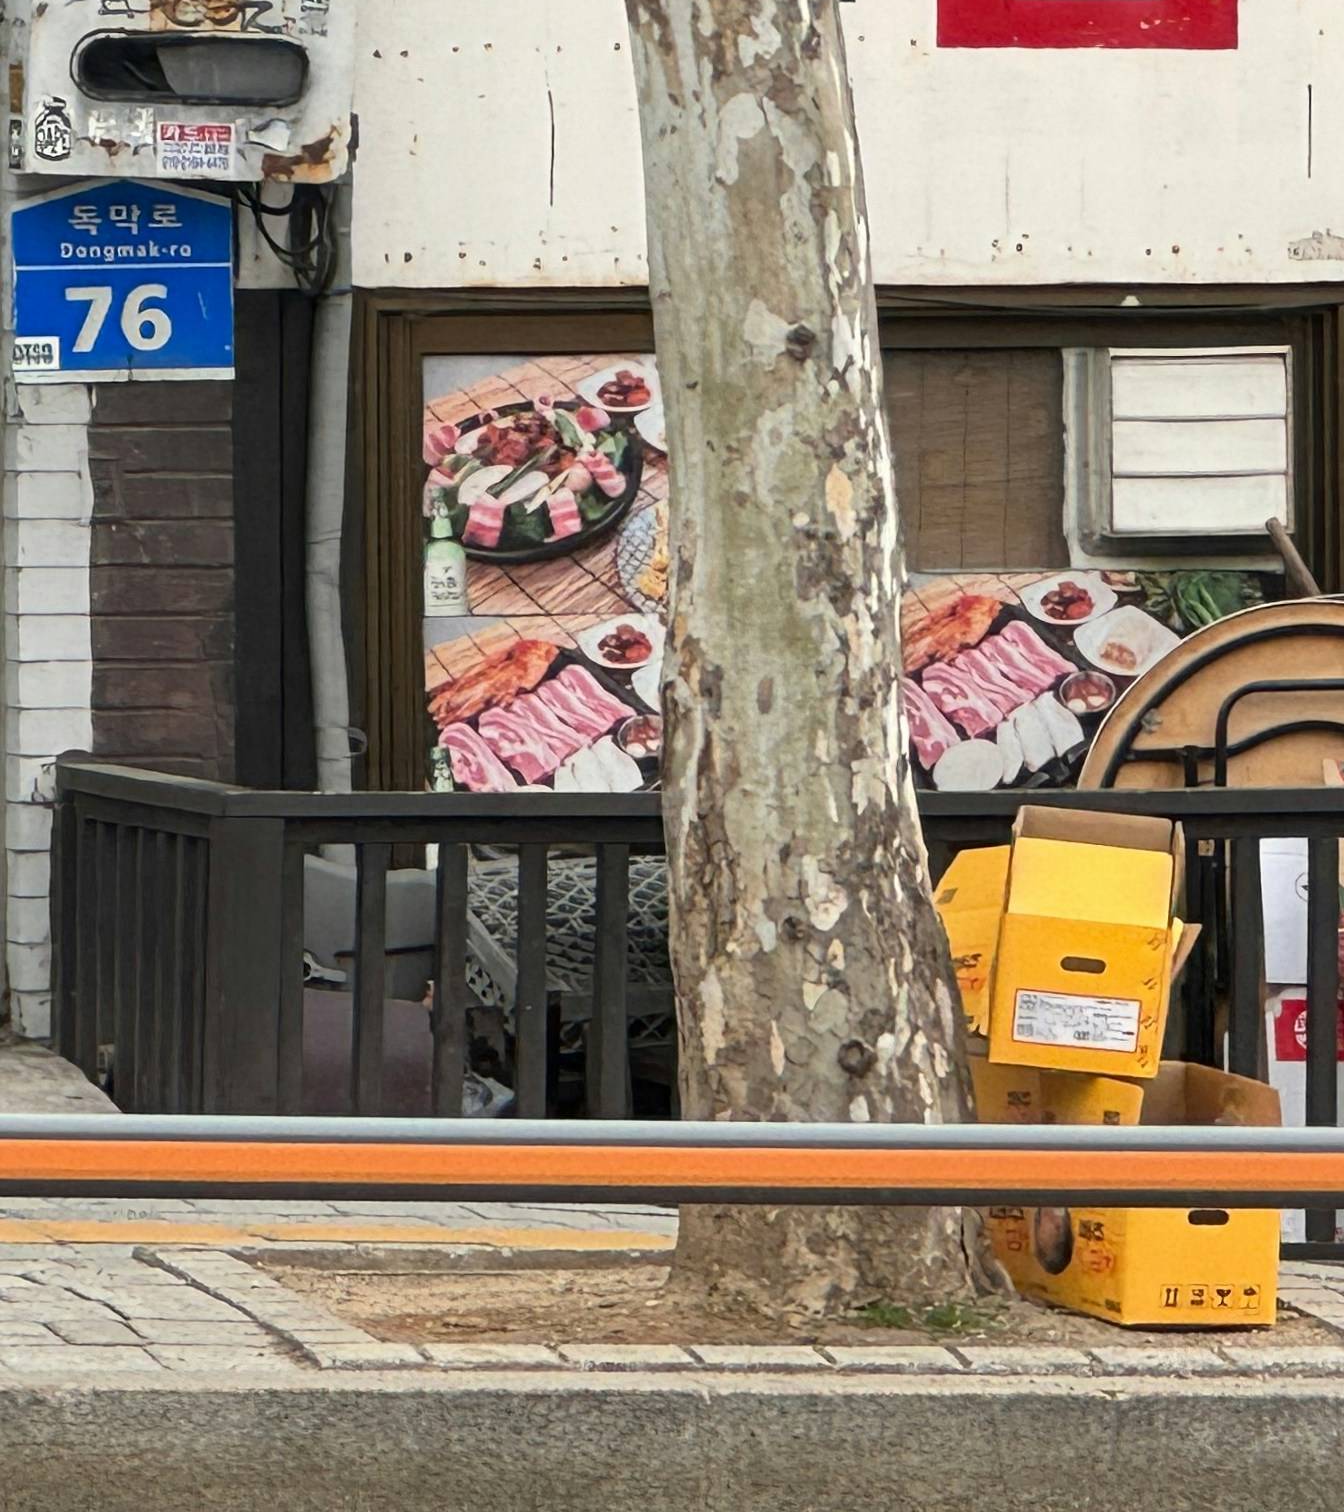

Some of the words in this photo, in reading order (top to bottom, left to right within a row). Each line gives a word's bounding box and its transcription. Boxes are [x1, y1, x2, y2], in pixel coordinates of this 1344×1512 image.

[68, 204, 183, 235] 독막로
[60, 241, 192, 262] Dongmak-ro
[64, 283, 173, 354] 76
